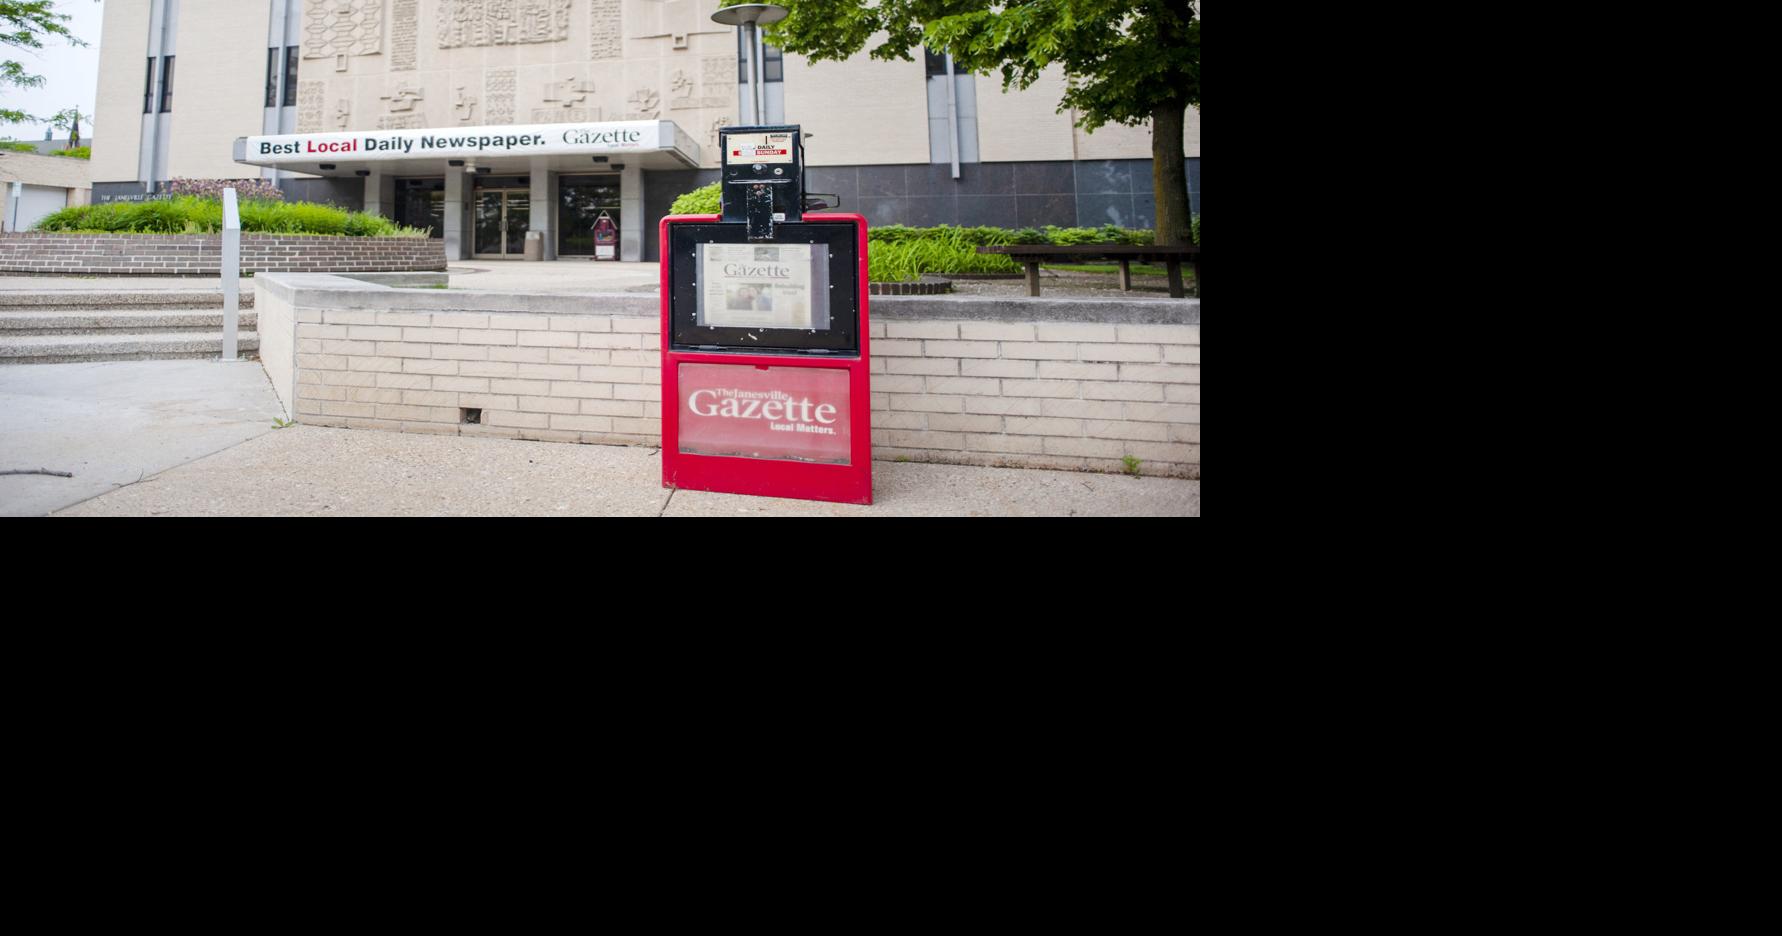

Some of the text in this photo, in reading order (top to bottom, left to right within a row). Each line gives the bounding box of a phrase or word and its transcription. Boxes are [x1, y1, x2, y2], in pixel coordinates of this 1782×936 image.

[260, 133, 546, 155] Best Local Daily Newspaper.
[562, 128, 641, 145] Gazette
[723, 262, 790, 278] Gazette
[715, 387, 788, 400] The Janesville
[688, 388, 837, 424] Gazette
[770, 421, 794, 432] Local
